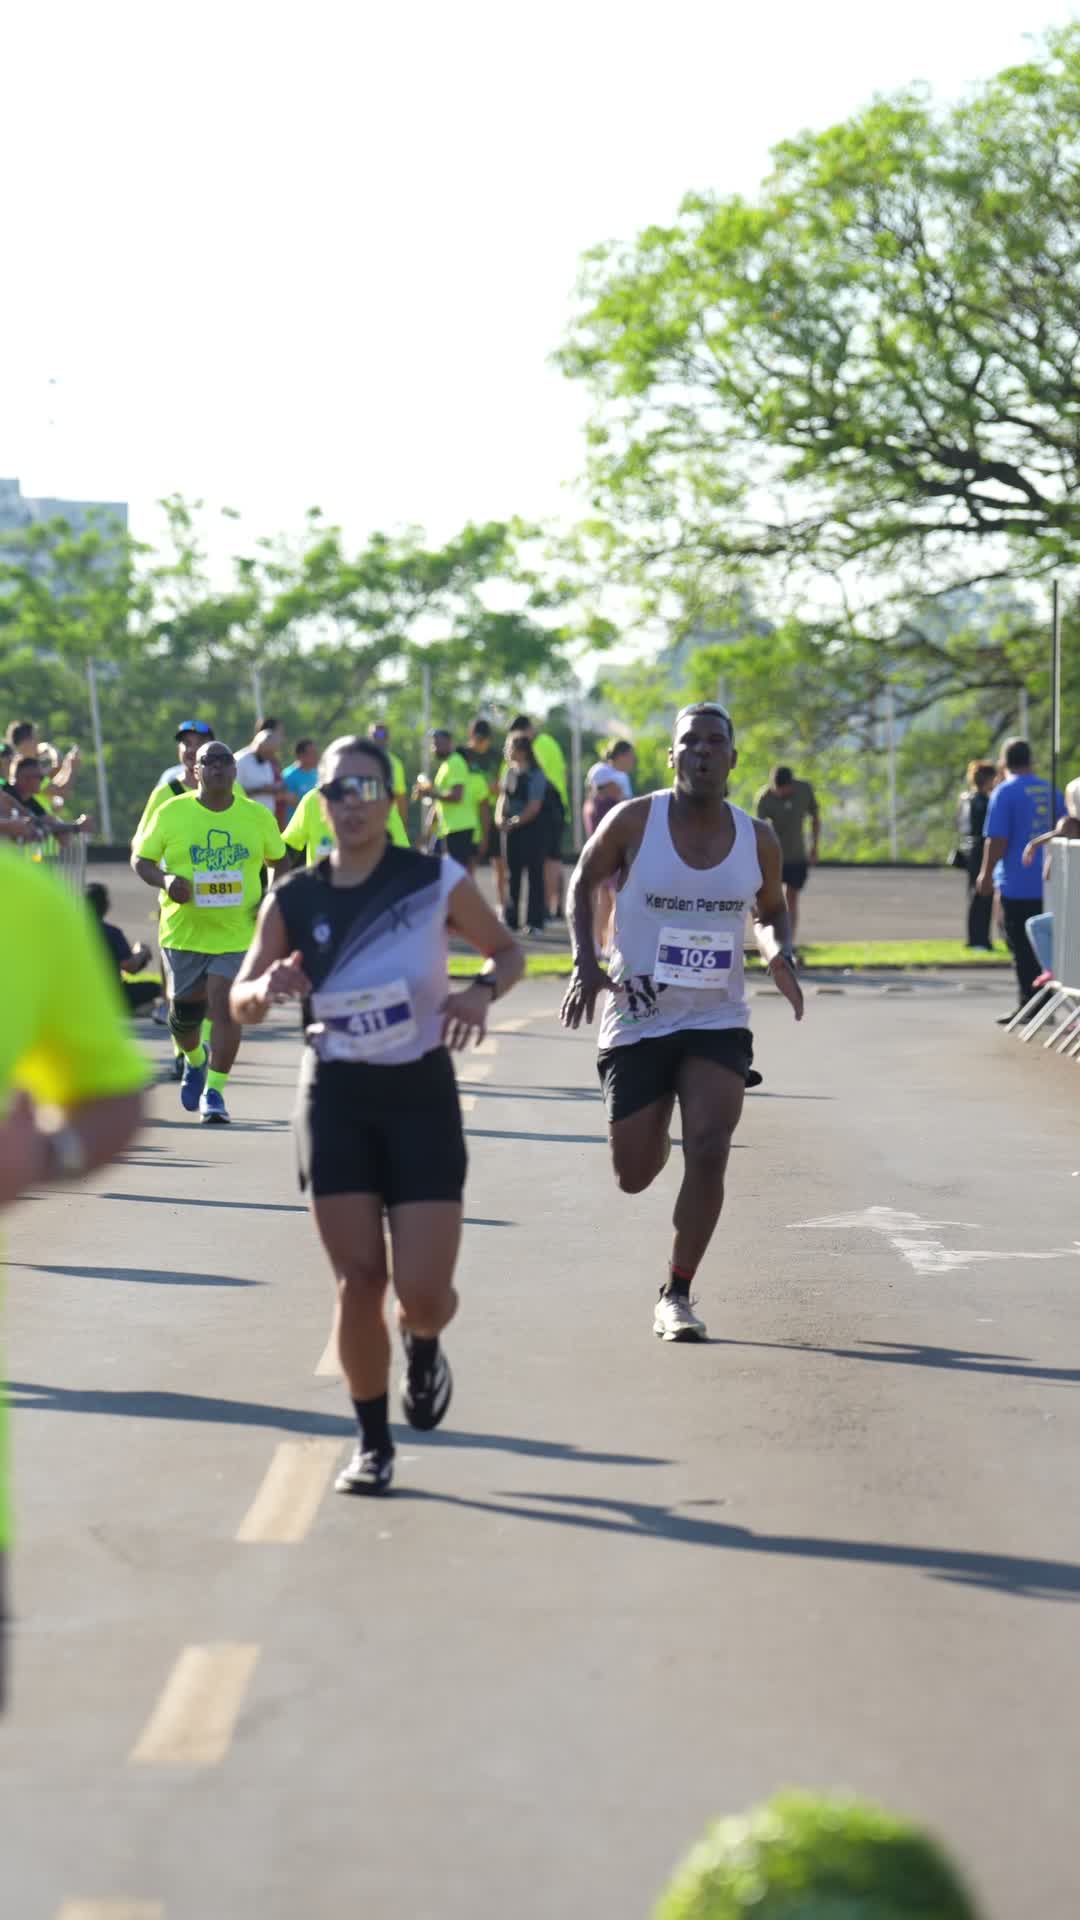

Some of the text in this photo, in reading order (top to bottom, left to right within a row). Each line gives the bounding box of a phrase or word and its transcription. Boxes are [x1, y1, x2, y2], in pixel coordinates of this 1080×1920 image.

[209, 883, 233, 895] 881
[645, 893, 693, 911] Kerolen
[680, 949, 717, 968] 106
[349, 1010, 388, 1036] 411
